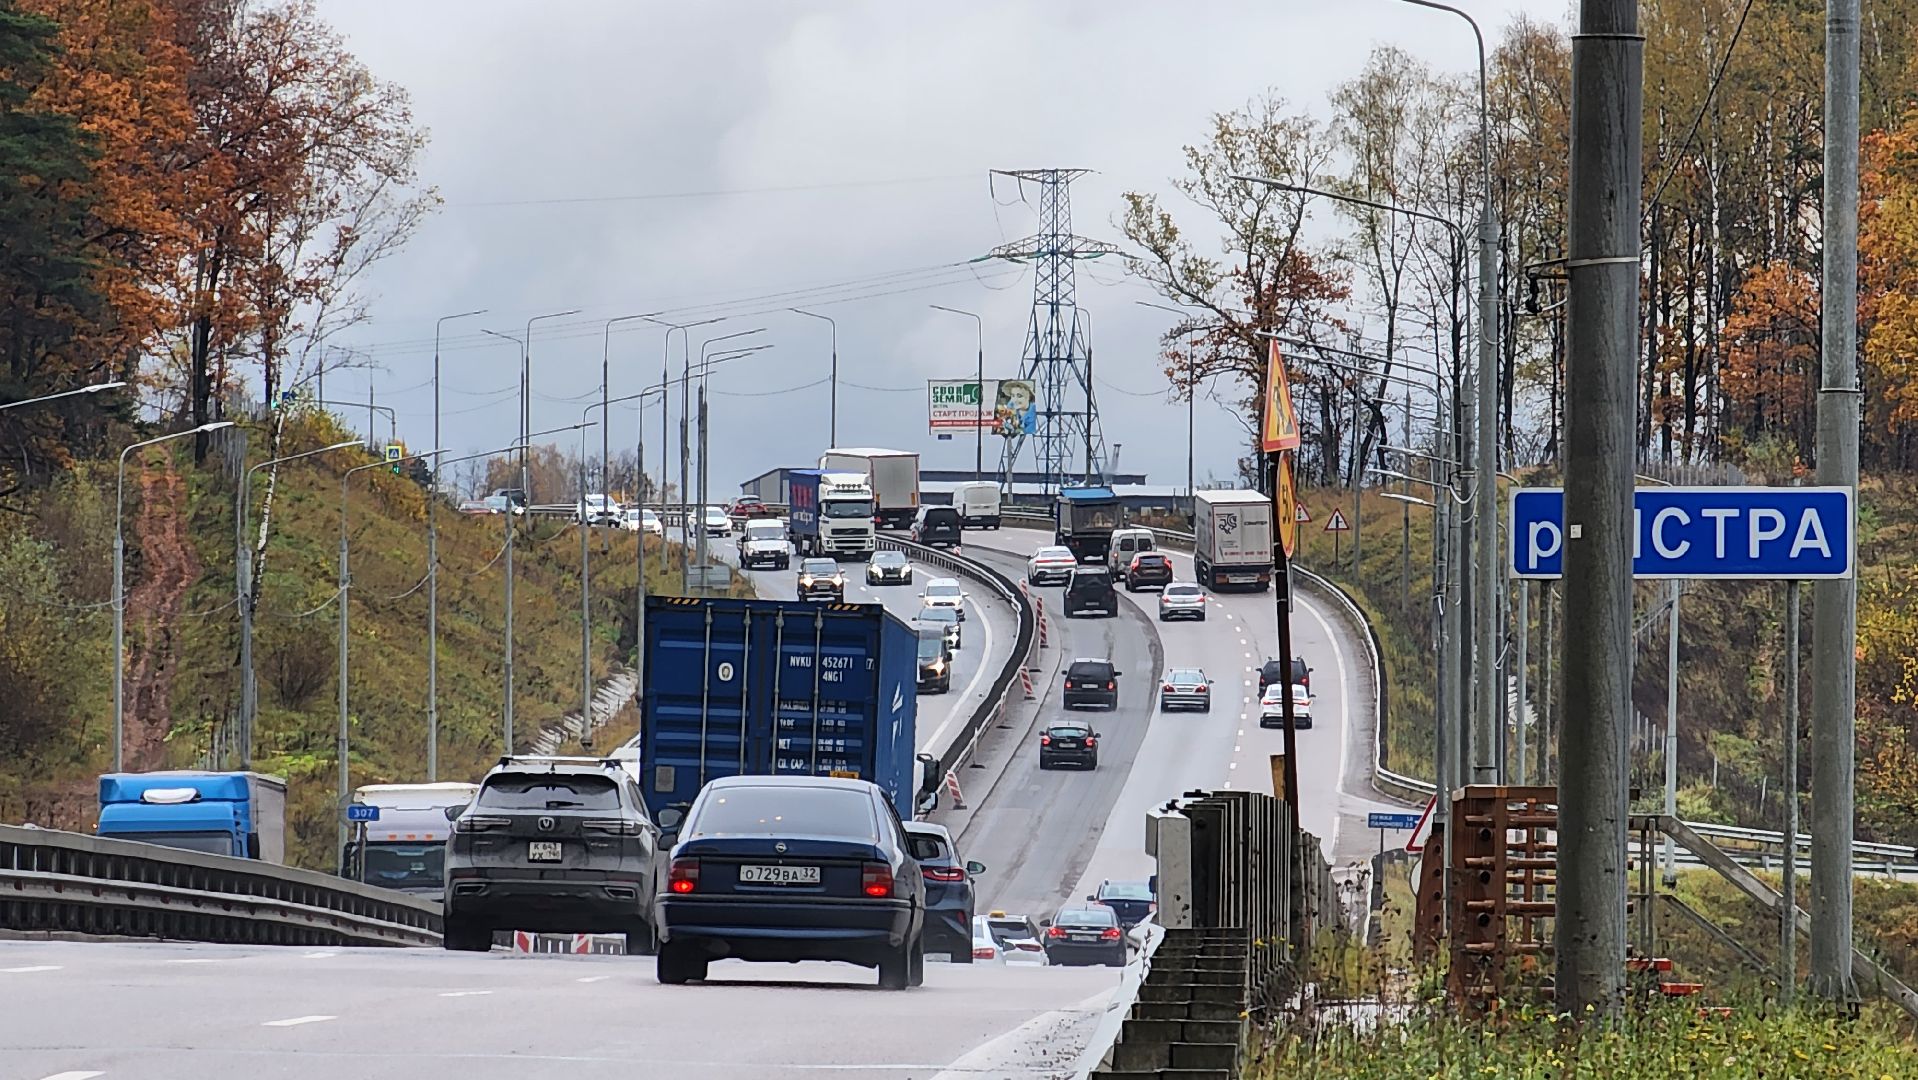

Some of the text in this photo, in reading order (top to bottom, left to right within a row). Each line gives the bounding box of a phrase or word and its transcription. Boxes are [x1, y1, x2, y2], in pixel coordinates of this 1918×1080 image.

[932, 386, 963, 395] СВОЯ
[933, 410, 993, 418] СТАРТ ПРОДАЖ
[1633, 506, 1832, 560] СТРА
[790, 656, 811, 667] NVKU
[822, 657, 853, 669] 452671
[779, 738, 791, 750] NET
[353, 808, 374, 818] 307
